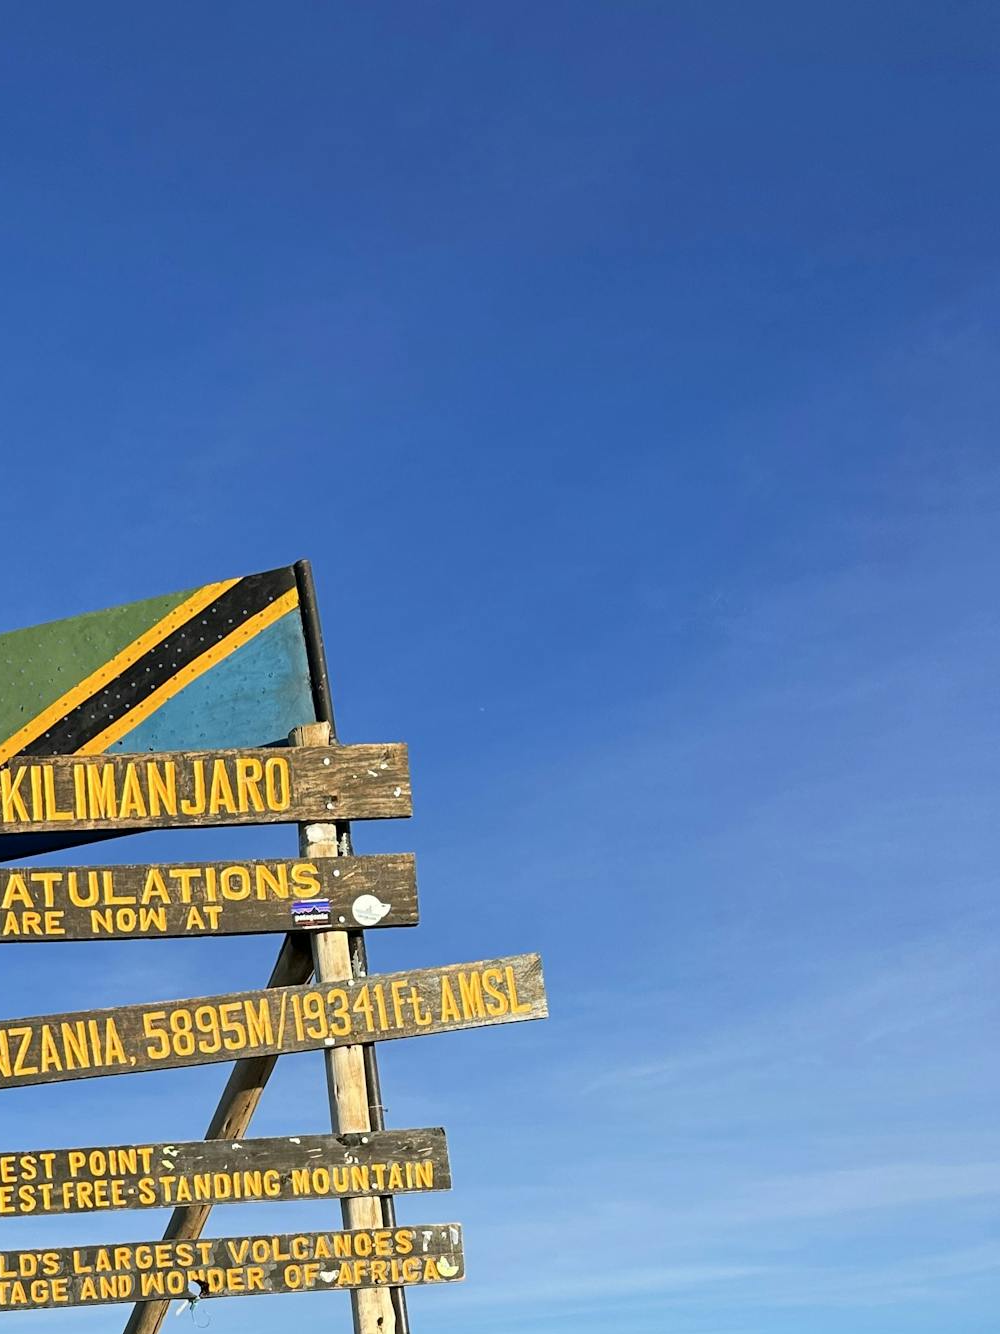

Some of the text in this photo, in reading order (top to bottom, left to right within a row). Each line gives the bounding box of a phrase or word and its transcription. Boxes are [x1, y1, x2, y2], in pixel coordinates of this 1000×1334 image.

[0, 756, 291, 824] KILIMANJARO
[2, 910, 66, 936] ARE
[90, 906, 168, 934] NOW
[186, 905, 223, 929] AT
[440, 965, 532, 1022] AMSL
[68, 1147, 153, 1177] POINT
[290, 1160, 434, 1195] MOUNTAIN
[73, 1242, 212, 1275] LARGEST
[228, 1229, 413, 1265] VOLCANOES
[80, 1274, 132, 1301] AND
[284, 1262, 319, 1289] OF
[336, 1256, 443, 1286] AFRICA
